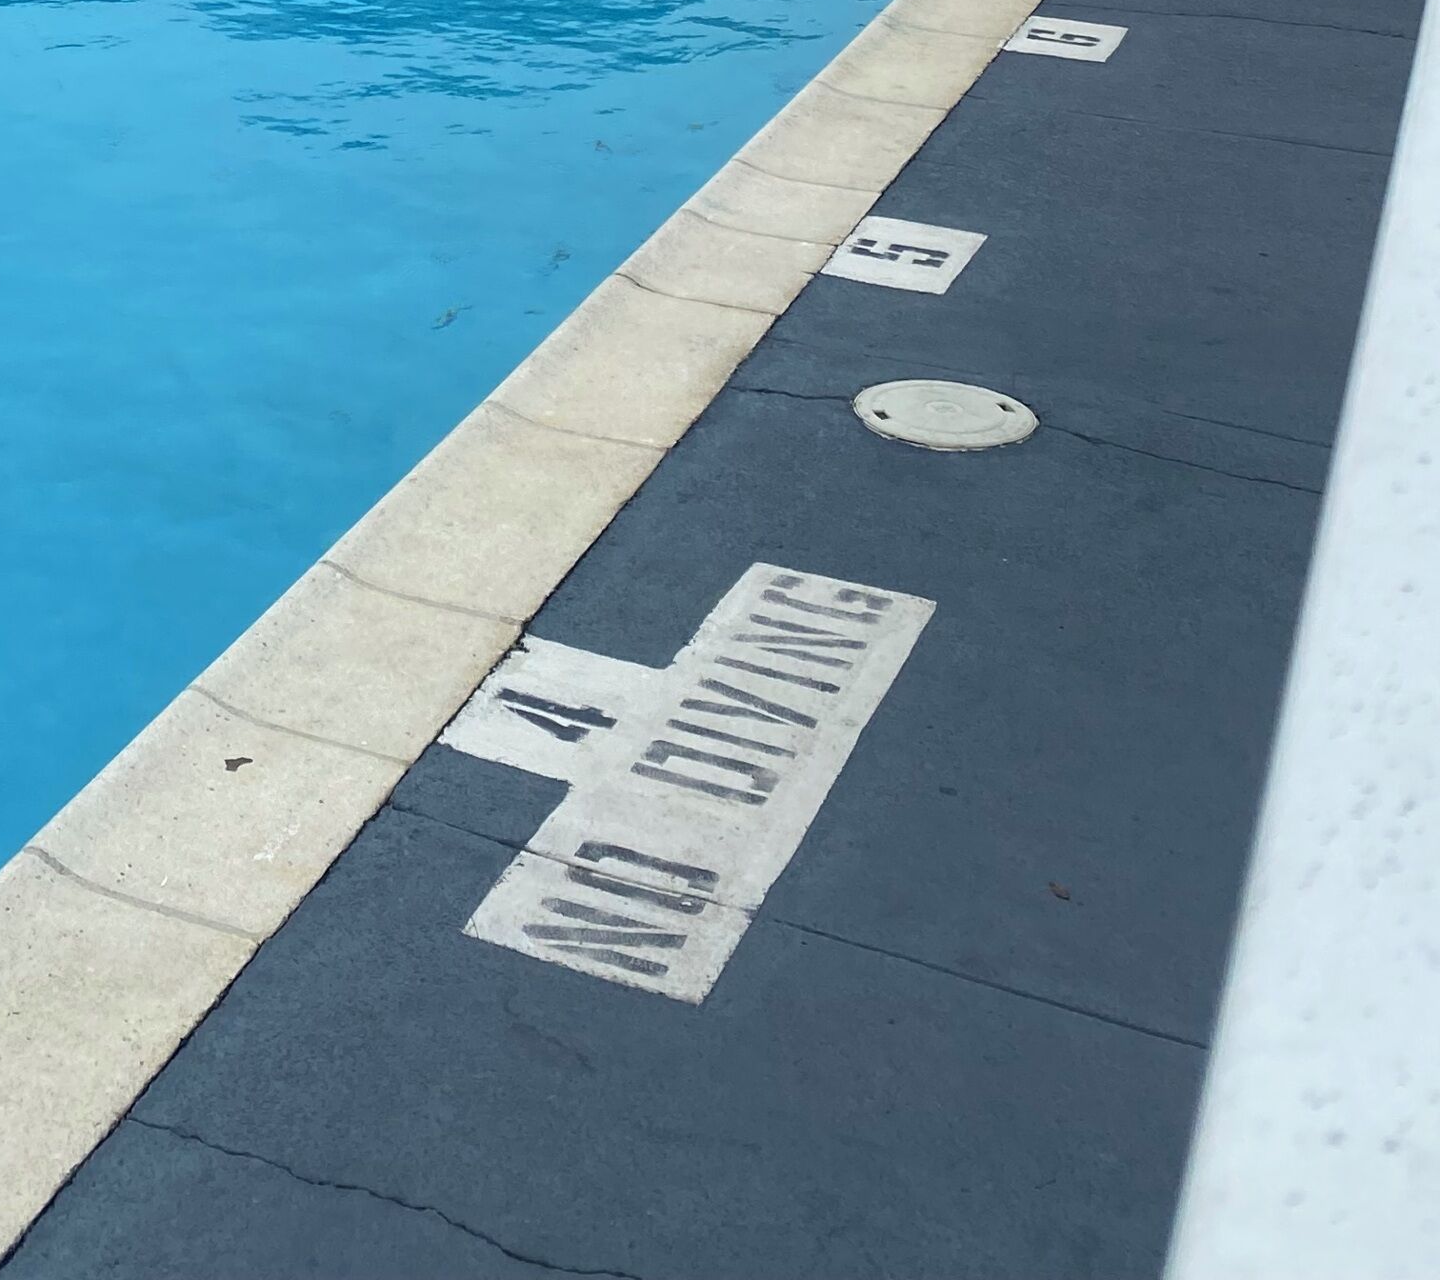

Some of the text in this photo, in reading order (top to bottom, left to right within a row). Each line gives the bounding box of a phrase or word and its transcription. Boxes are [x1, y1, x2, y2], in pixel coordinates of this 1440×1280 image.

[1026, 28, 1101, 47] 6
[848, 238, 950, 269] 5
[496, 687, 619, 743] 4
[522, 574, 894, 977] NO DIVING
